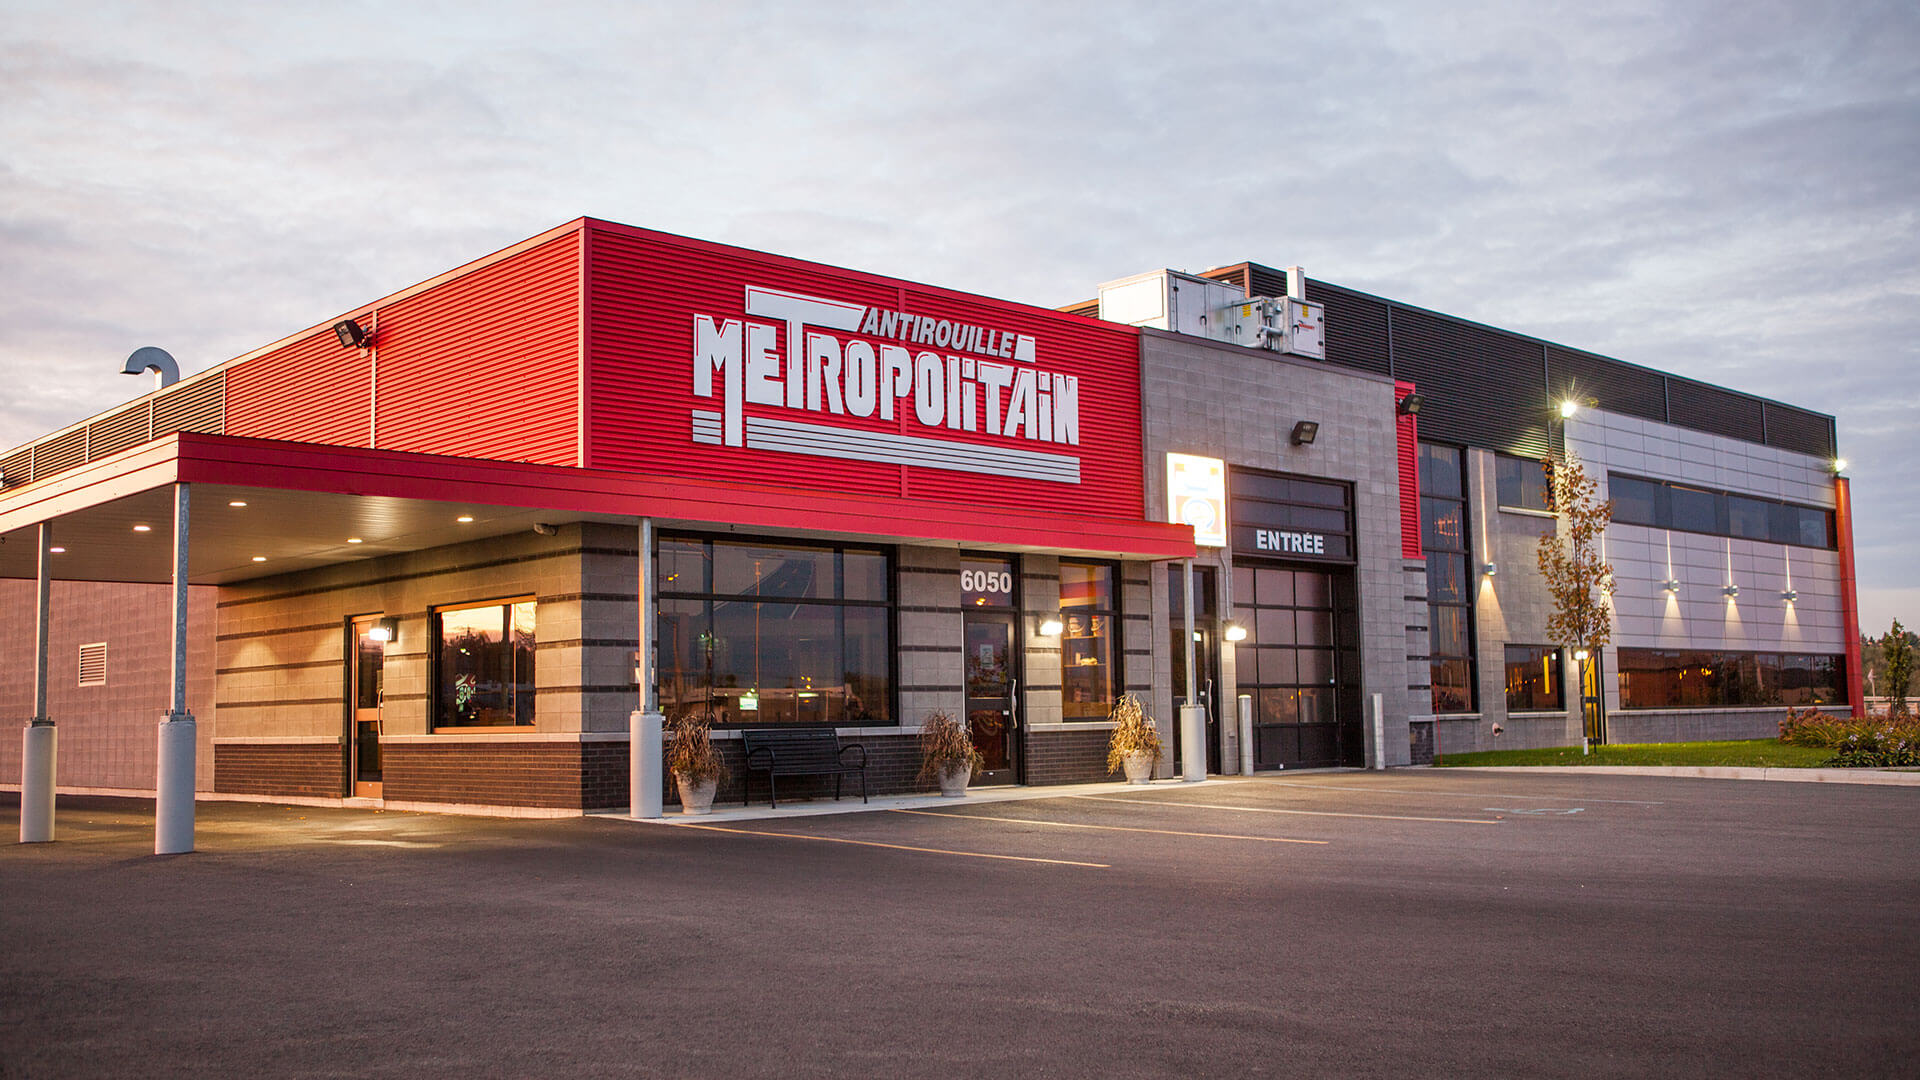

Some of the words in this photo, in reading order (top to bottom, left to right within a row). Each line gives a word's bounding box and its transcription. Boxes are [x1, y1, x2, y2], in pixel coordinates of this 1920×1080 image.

[861, 307, 1015, 358] ANTIROUILLE
[1256, 529, 1324, 554] ENTRÉE
[960, 569, 1012, 594] 6050
